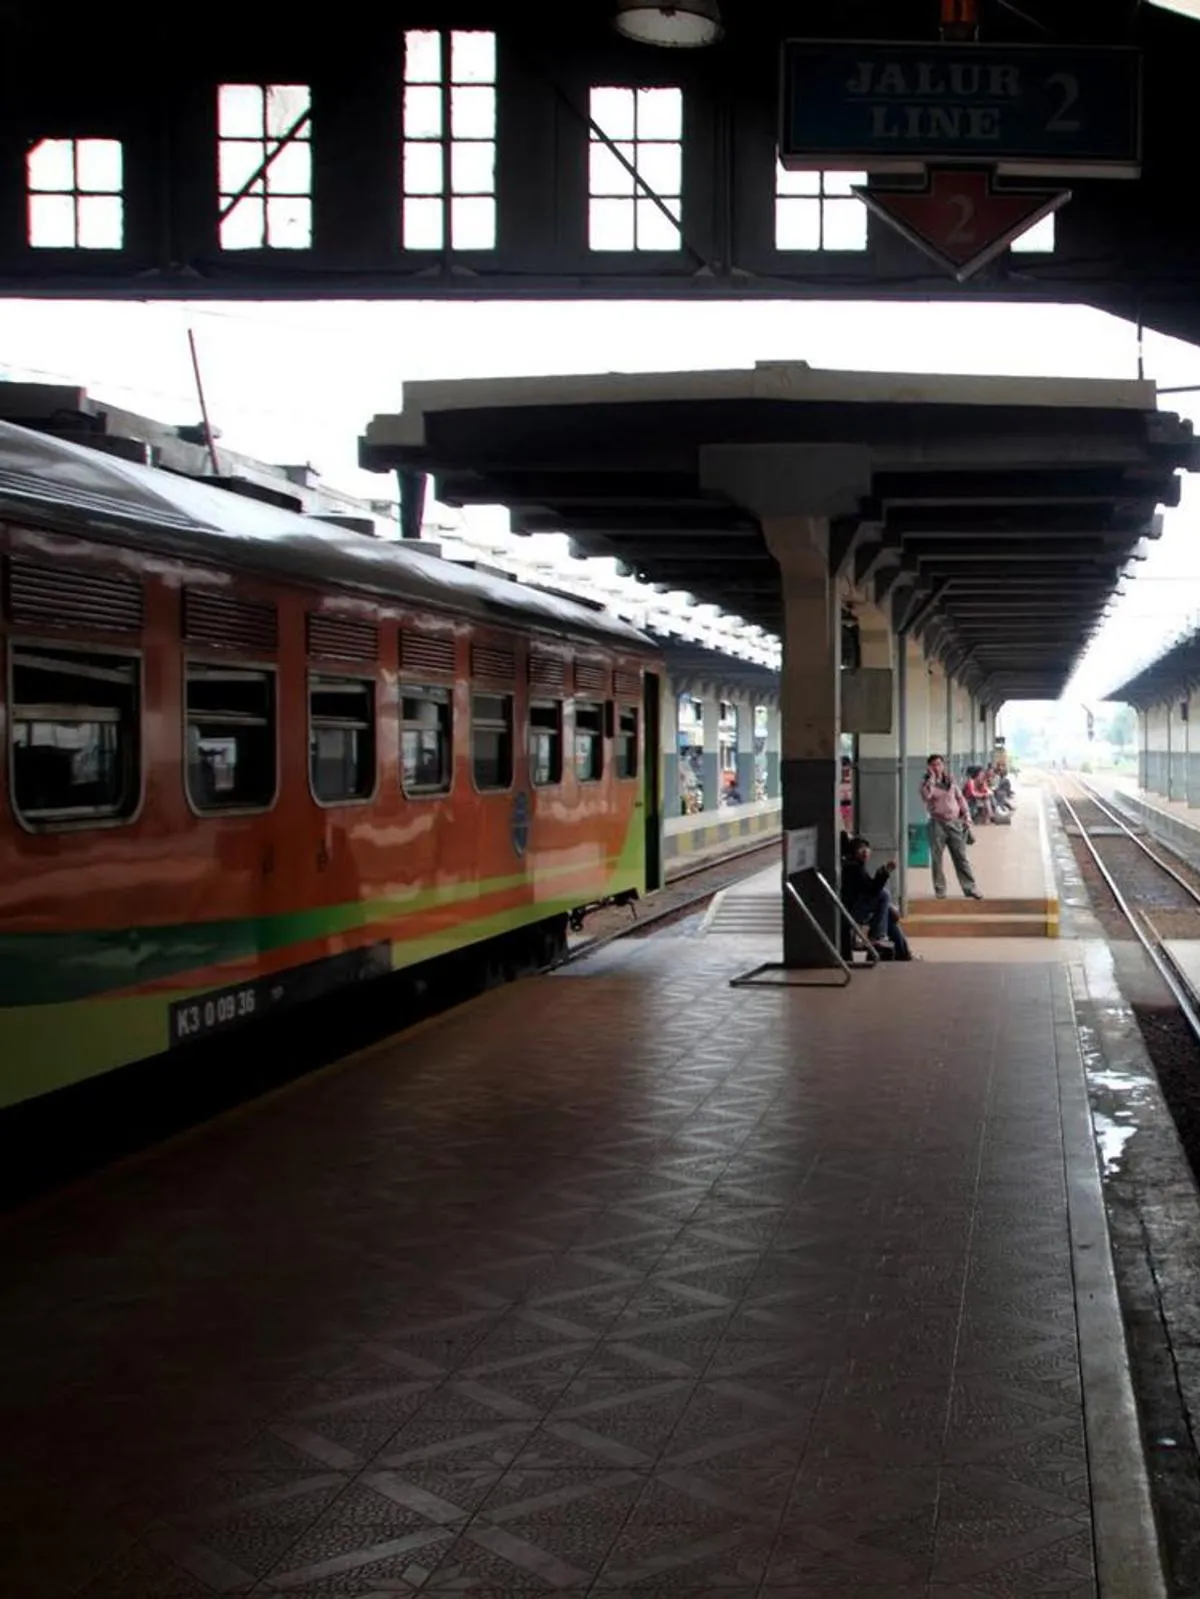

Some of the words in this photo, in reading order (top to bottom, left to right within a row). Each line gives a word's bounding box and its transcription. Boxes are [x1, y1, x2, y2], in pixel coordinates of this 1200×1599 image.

[846, 61, 1022, 96] JALUR
[1043, 72, 1080, 132] 2
[871, 106, 1001, 139] LINE
[946, 194, 975, 243] 2
[177, 1006, 200, 1037] K3
